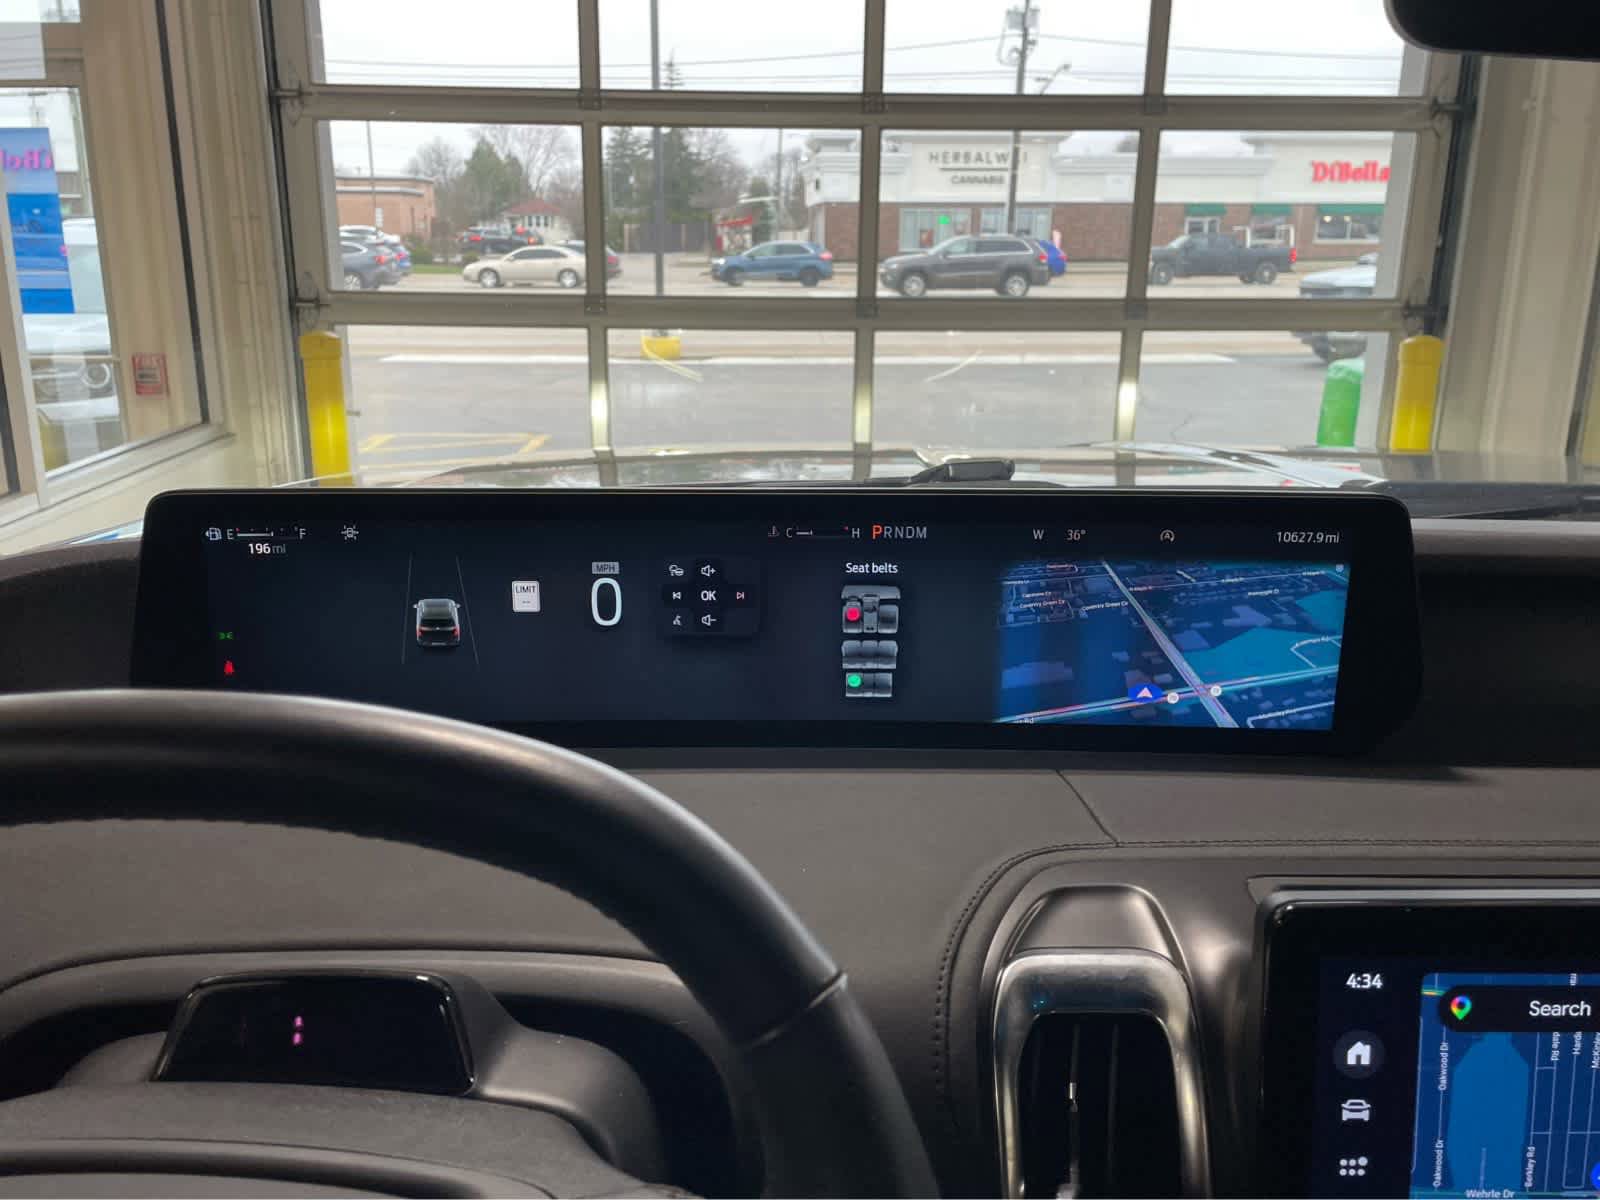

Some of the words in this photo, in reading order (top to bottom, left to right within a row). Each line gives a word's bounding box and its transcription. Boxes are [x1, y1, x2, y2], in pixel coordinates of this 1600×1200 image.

[226, 528, 235, 540] E
[299, 528, 307, 540] F
[786, 527, 793, 538] C
[851, 528, 860, 538] H
[872, 525, 928, 540] PRNDM
[1033, 529, 1044, 540] W
[1066, 528, 1087, 541] 36°
[596, 563, 616, 573] MPH
[845, 562, 870, 574] Seat
[871, 562, 899, 574] belts
[515, 584, 537, 594] LIMIT
[700, 589, 717, 602] OK
[591, 577, 622, 627] 0
[1346, 972, 1384, 990] 4:34
[1528, 1000, 1592, 1017] Search
[1440, 1042, 1449, 1051] Dr
[1438, 1052, 1449, 1091] Oakwood
[1435, 1139, 1444, 1148] Dr
[1525, 1146, 1536, 1158] Rd
[1432, 1149, 1443, 1188] Oakwood
[1465, 1189, 1501, 1198] Wehrle
[1503, 1188, 1515, 1198] Dr
